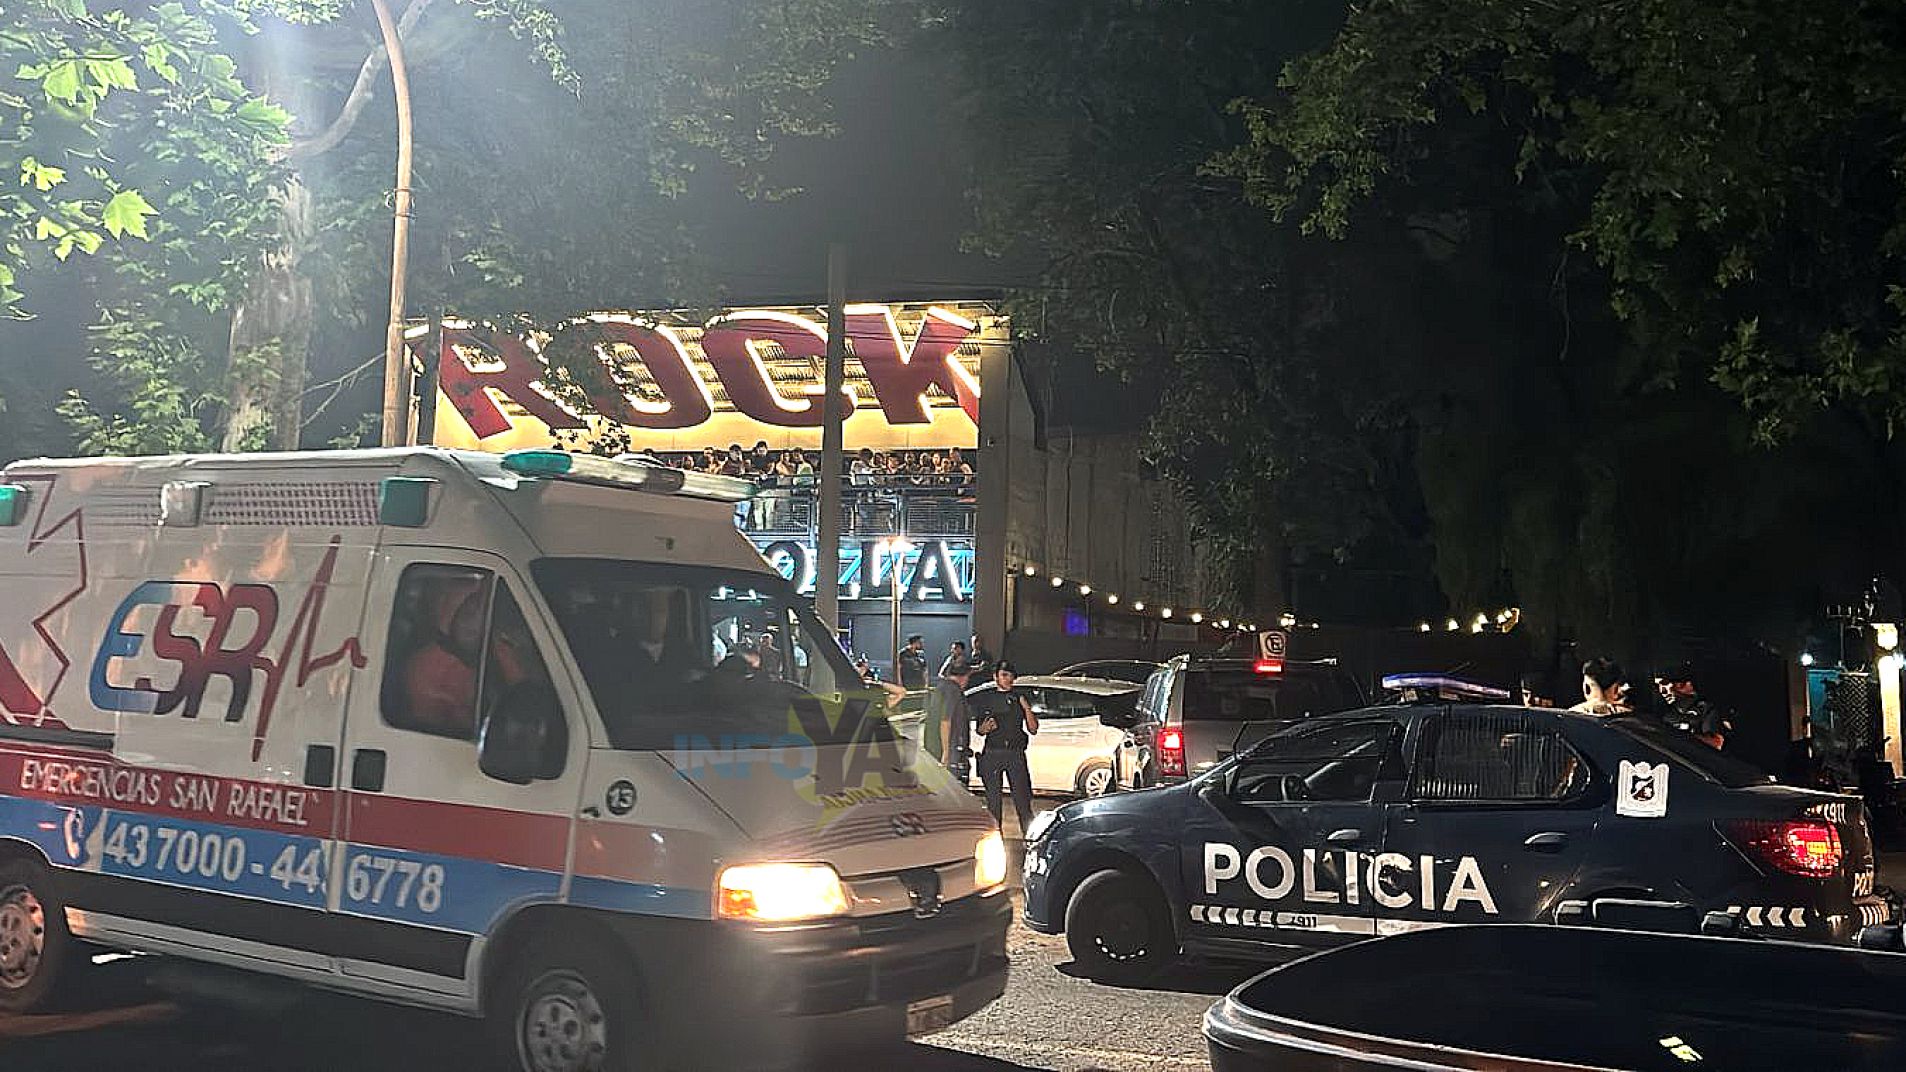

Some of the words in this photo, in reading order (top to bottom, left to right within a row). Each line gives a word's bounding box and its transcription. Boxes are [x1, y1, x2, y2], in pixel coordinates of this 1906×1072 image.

[438, 304, 981, 439] ROCK
[89, 580, 279, 723] ESR
[169, 776, 220, 814] SAN
[226, 783, 309, 825] RAFAEL
[1203, 841, 1499, 914] POLICIA
